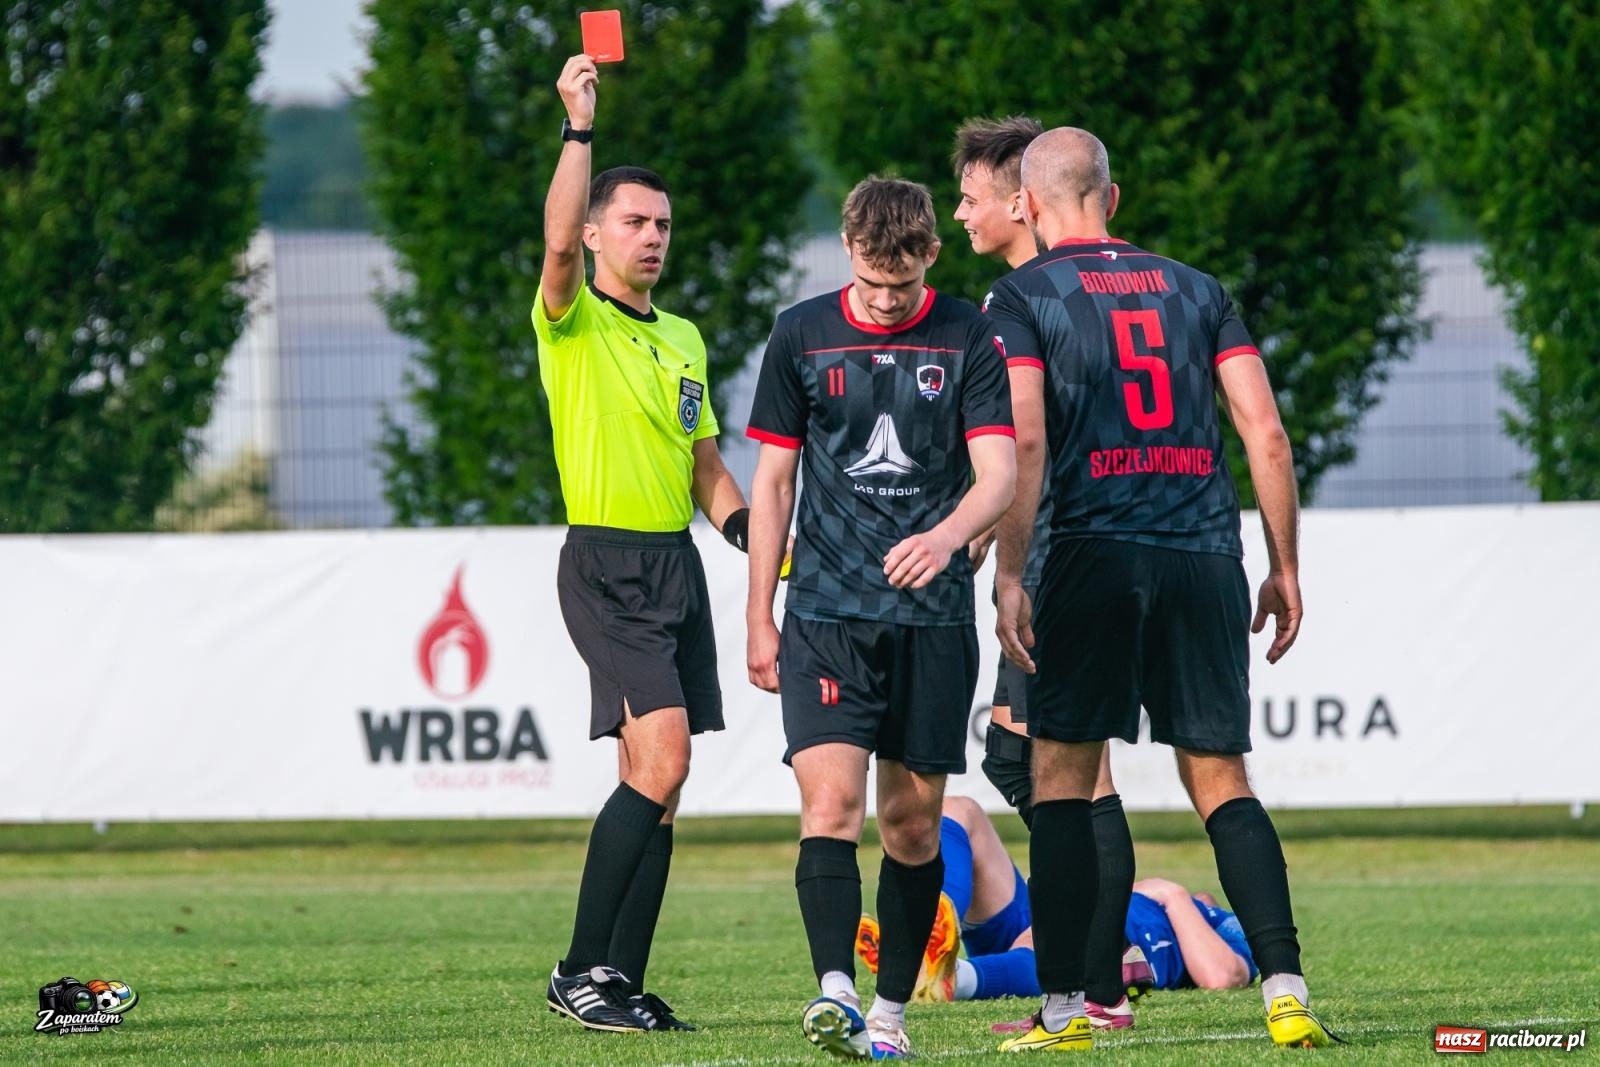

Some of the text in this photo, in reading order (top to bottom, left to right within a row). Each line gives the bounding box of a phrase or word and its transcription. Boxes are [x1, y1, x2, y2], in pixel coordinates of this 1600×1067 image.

[1078, 269, 1169, 295] BOROWIK
[827, 367, 844, 396] 11
[1110, 309, 1174, 431] 5
[1090, 447, 1216, 479] SZCZEJKOWICE
[879, 487, 920, 496] GROUP
[820, 677, 839, 704] 11
[1264, 697, 1398, 739] URA
[359, 707, 549, 763] WRBA
